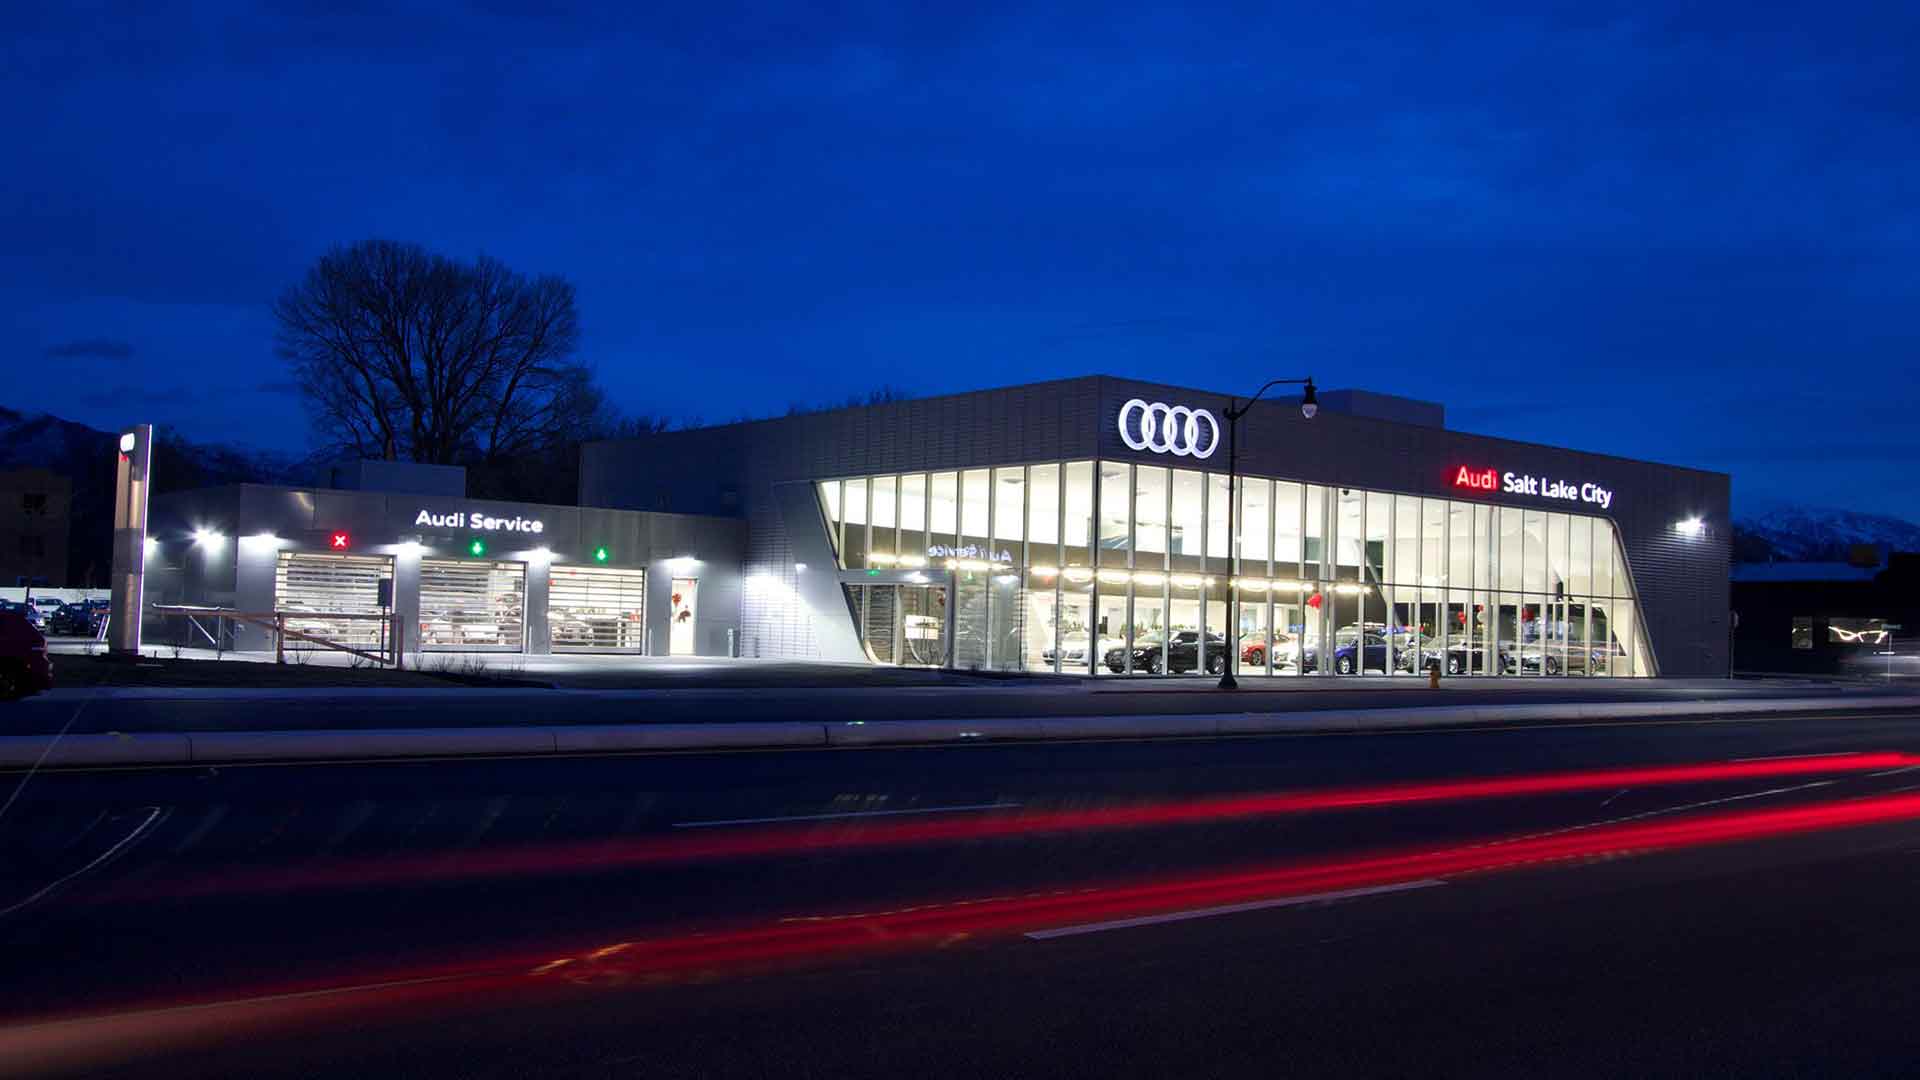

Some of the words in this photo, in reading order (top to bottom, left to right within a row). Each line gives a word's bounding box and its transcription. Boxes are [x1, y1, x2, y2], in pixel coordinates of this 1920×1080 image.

[1455, 466, 1498, 489] Audi
[1503, 472, 1538, 496] Salt
[1541, 477, 1578, 500] Lake
[1581, 482, 1613, 509] City
[415, 509, 465, 527] Audi
[470, 512, 544, 533] Service
